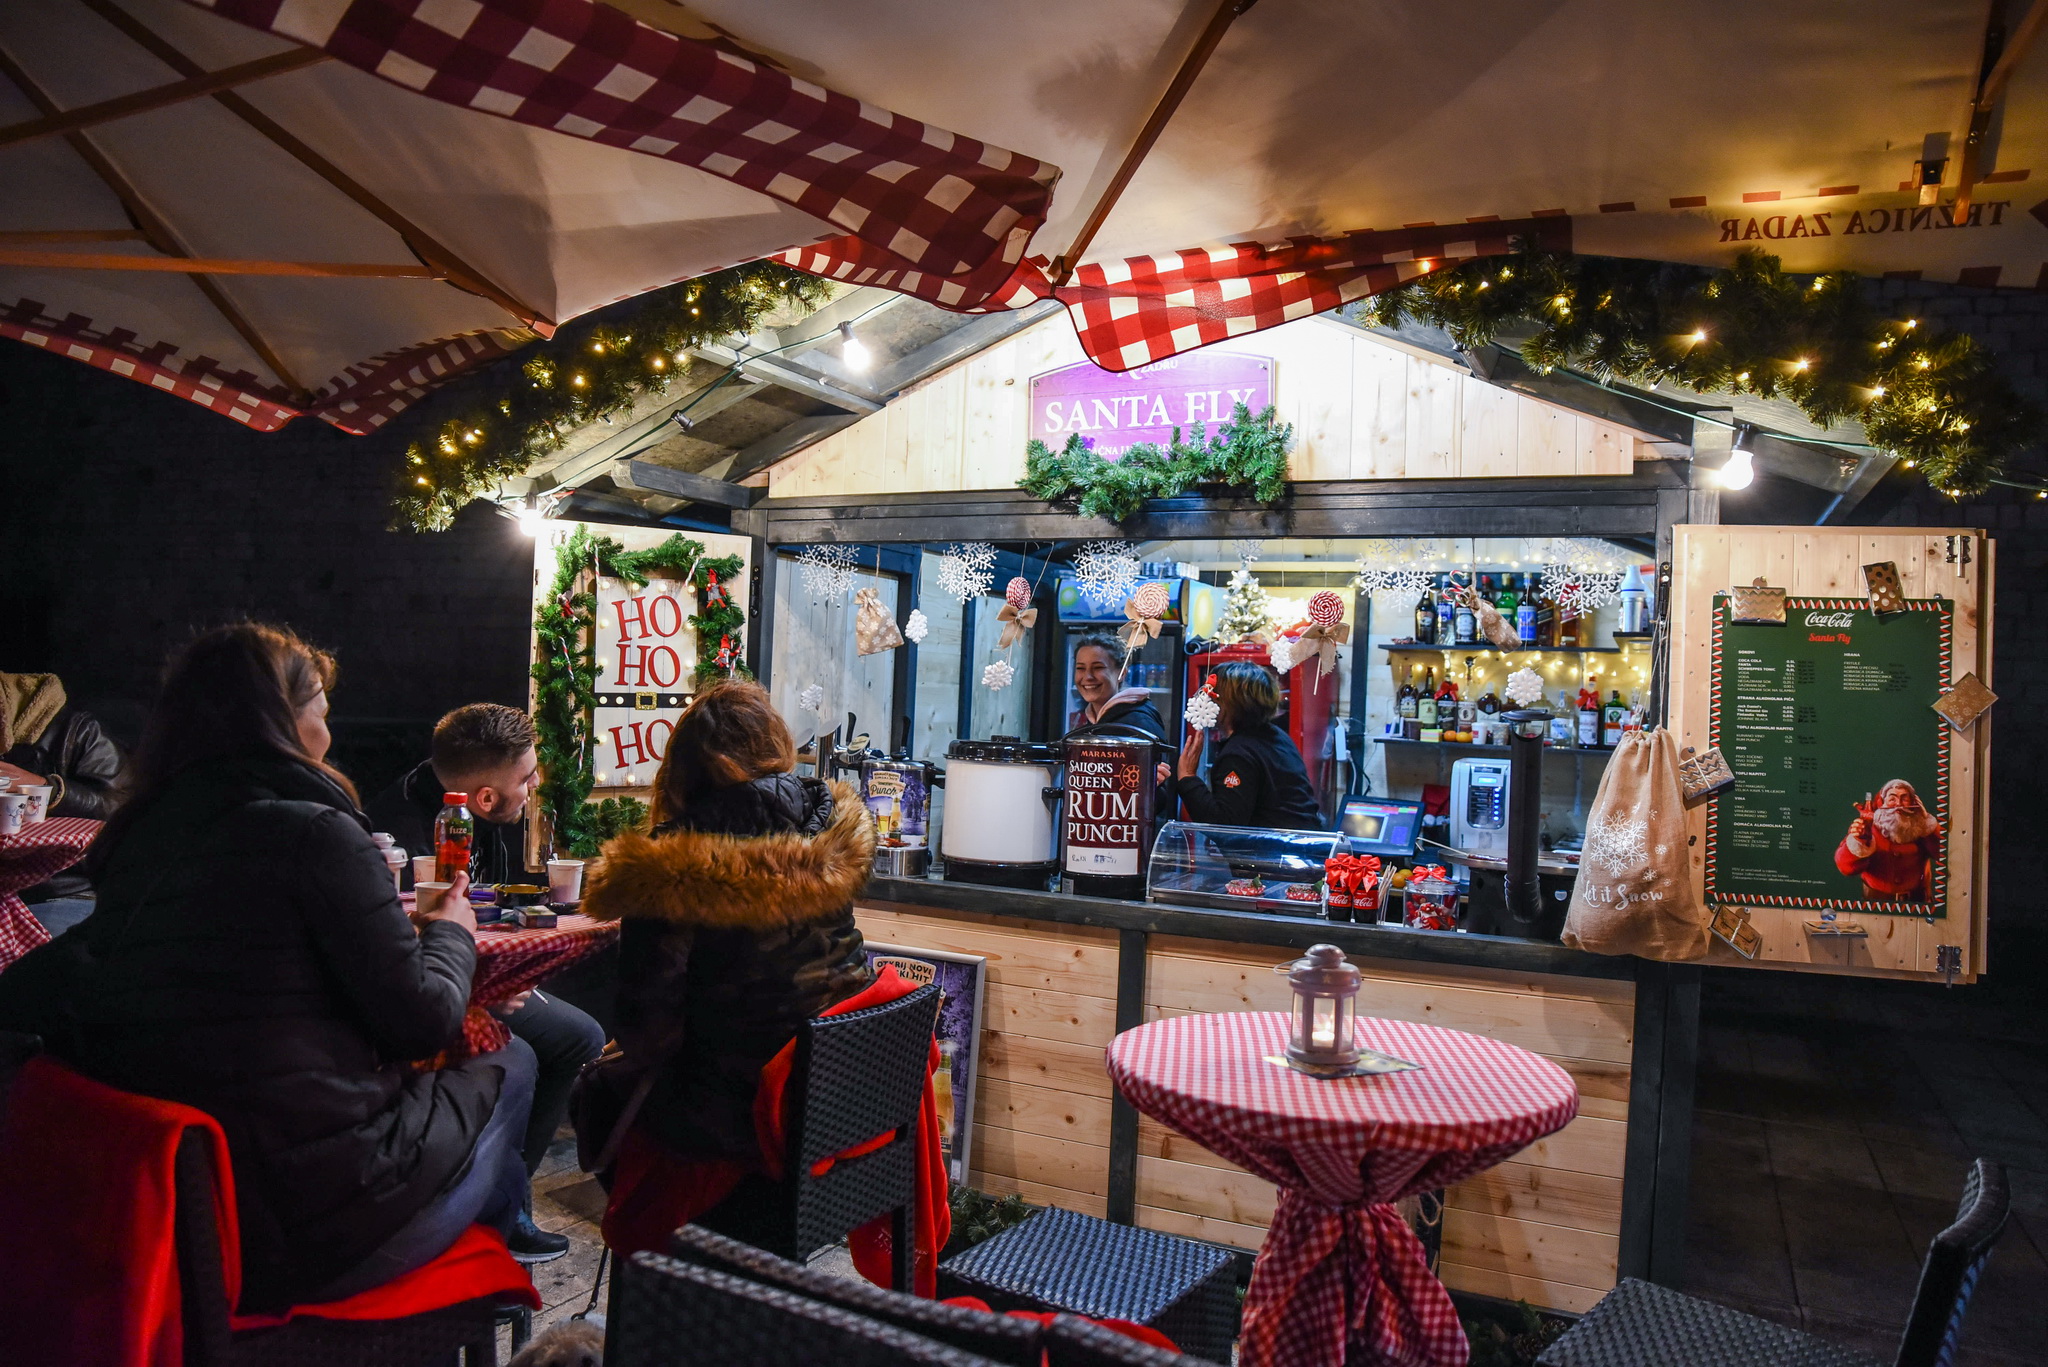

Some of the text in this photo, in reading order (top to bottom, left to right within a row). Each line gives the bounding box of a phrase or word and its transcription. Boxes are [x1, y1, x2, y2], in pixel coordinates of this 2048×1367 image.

[1045, 388, 1256, 433] SANTA FLY
[611, 594, 682, 643] HO
[1804, 611, 1855, 628] Coca-Cola
[1808, 632, 1851, 645] Santa Fly
[614, 643, 681, 688] HO
[1080, 750, 1126, 758] MARASKA
[1069, 760, 1113, 775] SAILOR'S
[1069, 775, 1113, 789] QUEEN
[870, 784, 897, 796] Punch
[1068, 790, 1140, 820] RUM
[450, 826, 467, 834] fuze
[1067, 822, 1138, 842] PUNCH
[1582, 880, 1662, 910] Let it Snow
[909, 964, 932, 974] NOVI
[912, 973, 930, 983] HIT
